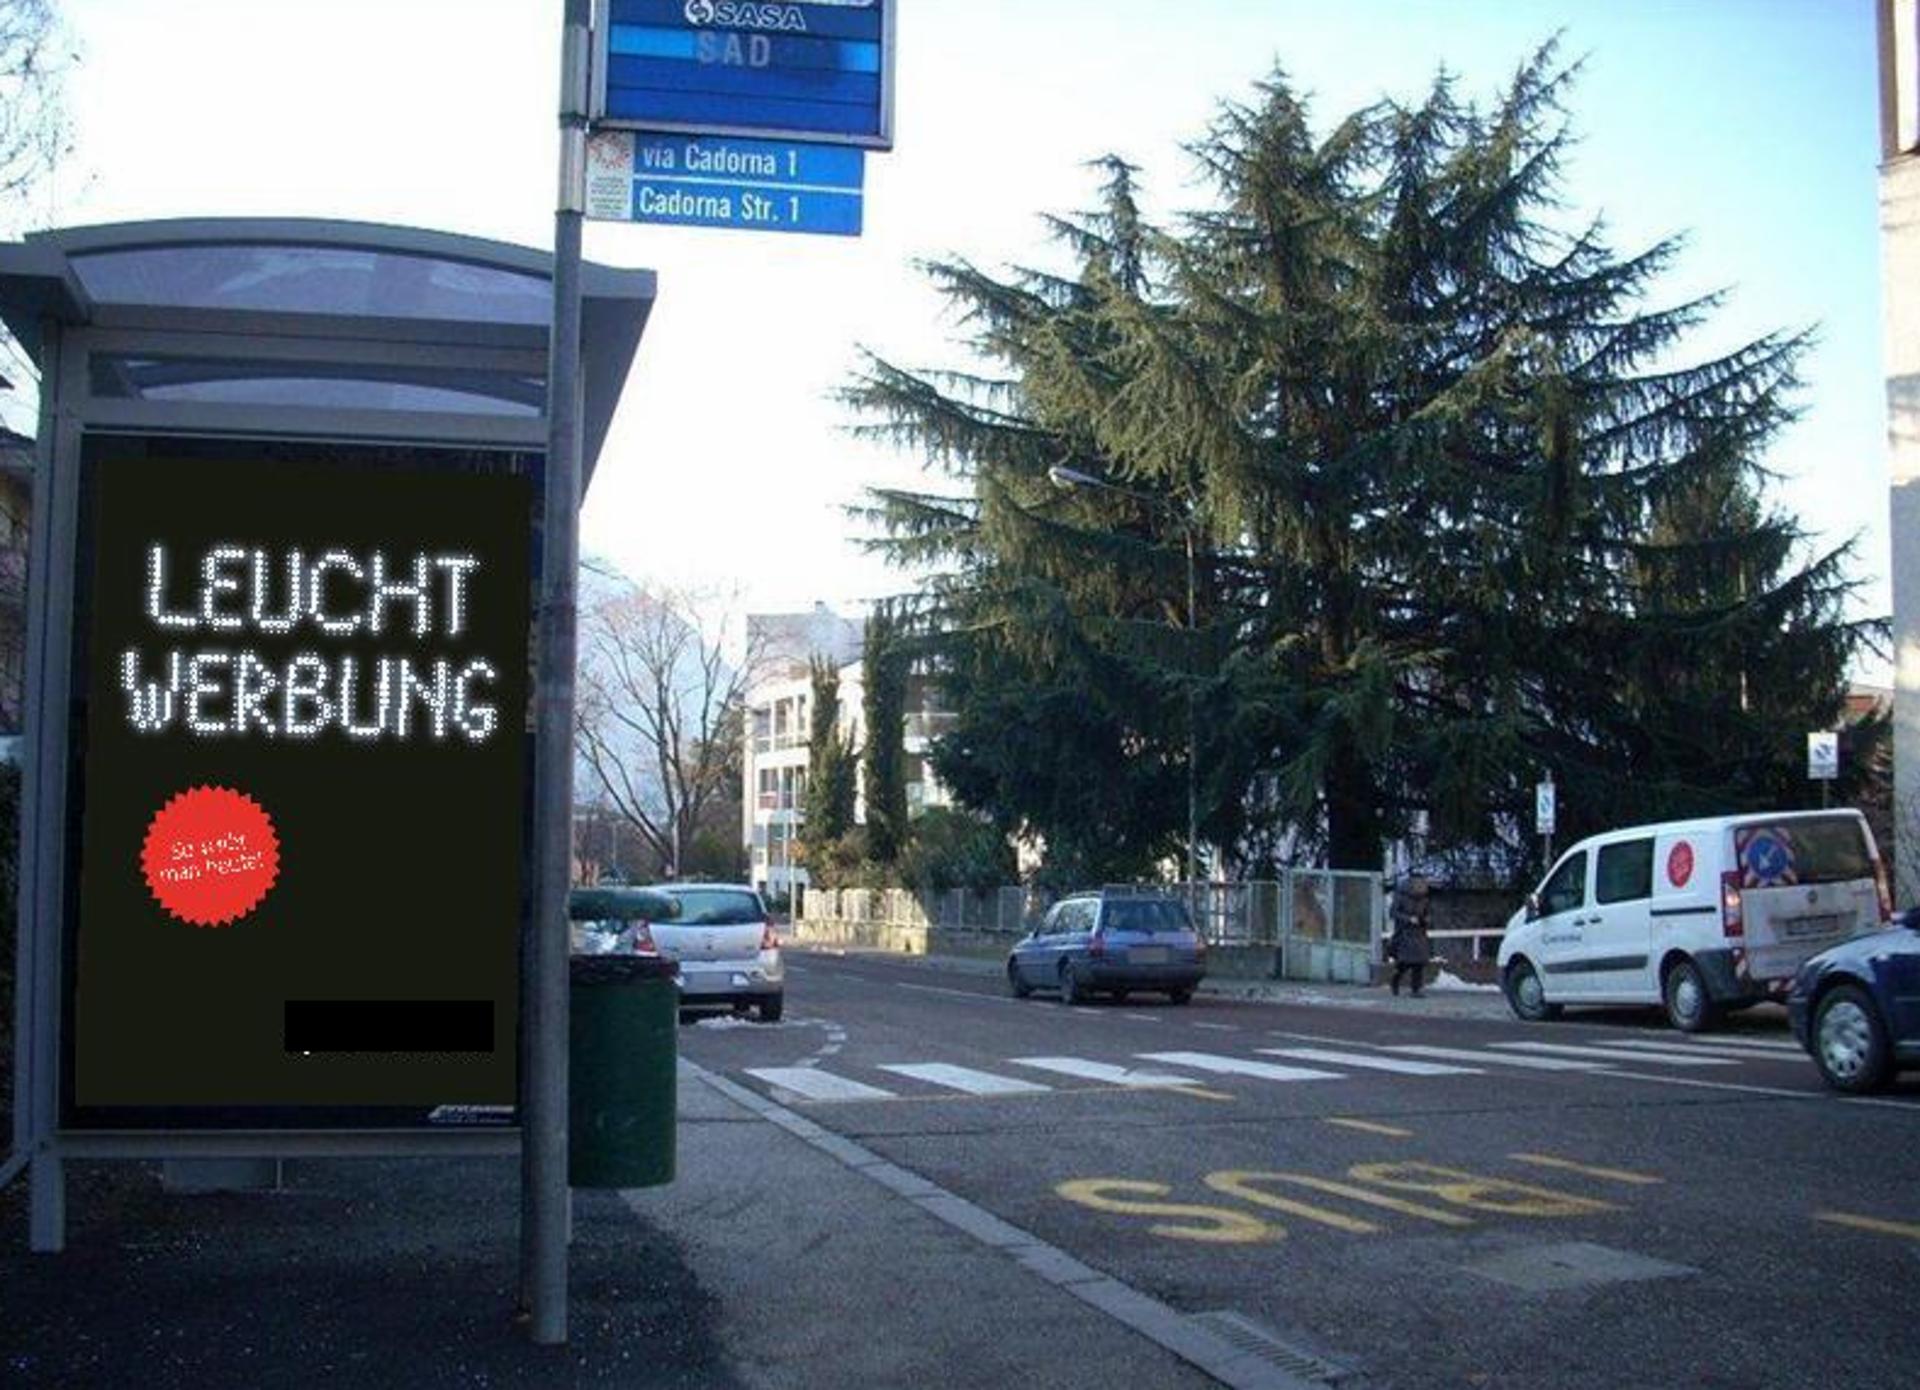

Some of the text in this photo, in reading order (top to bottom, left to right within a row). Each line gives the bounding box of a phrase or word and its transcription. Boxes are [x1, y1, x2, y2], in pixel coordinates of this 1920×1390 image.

[714, 1, 807, 31] SASA
[696, 30, 771, 68] SAD
[643, 143, 798, 177] via Cadorna 1
[639, 186, 732, 219] Cadorna
[740, 192, 780, 222] Str.
[790, 196, 800, 223] 1
[147, 544, 480, 638] LEUCHT
[120, 649, 498, 740] WERBUNG
[160, 866, 201, 882] man
[1054, 1160, 1632, 1244] BUS
